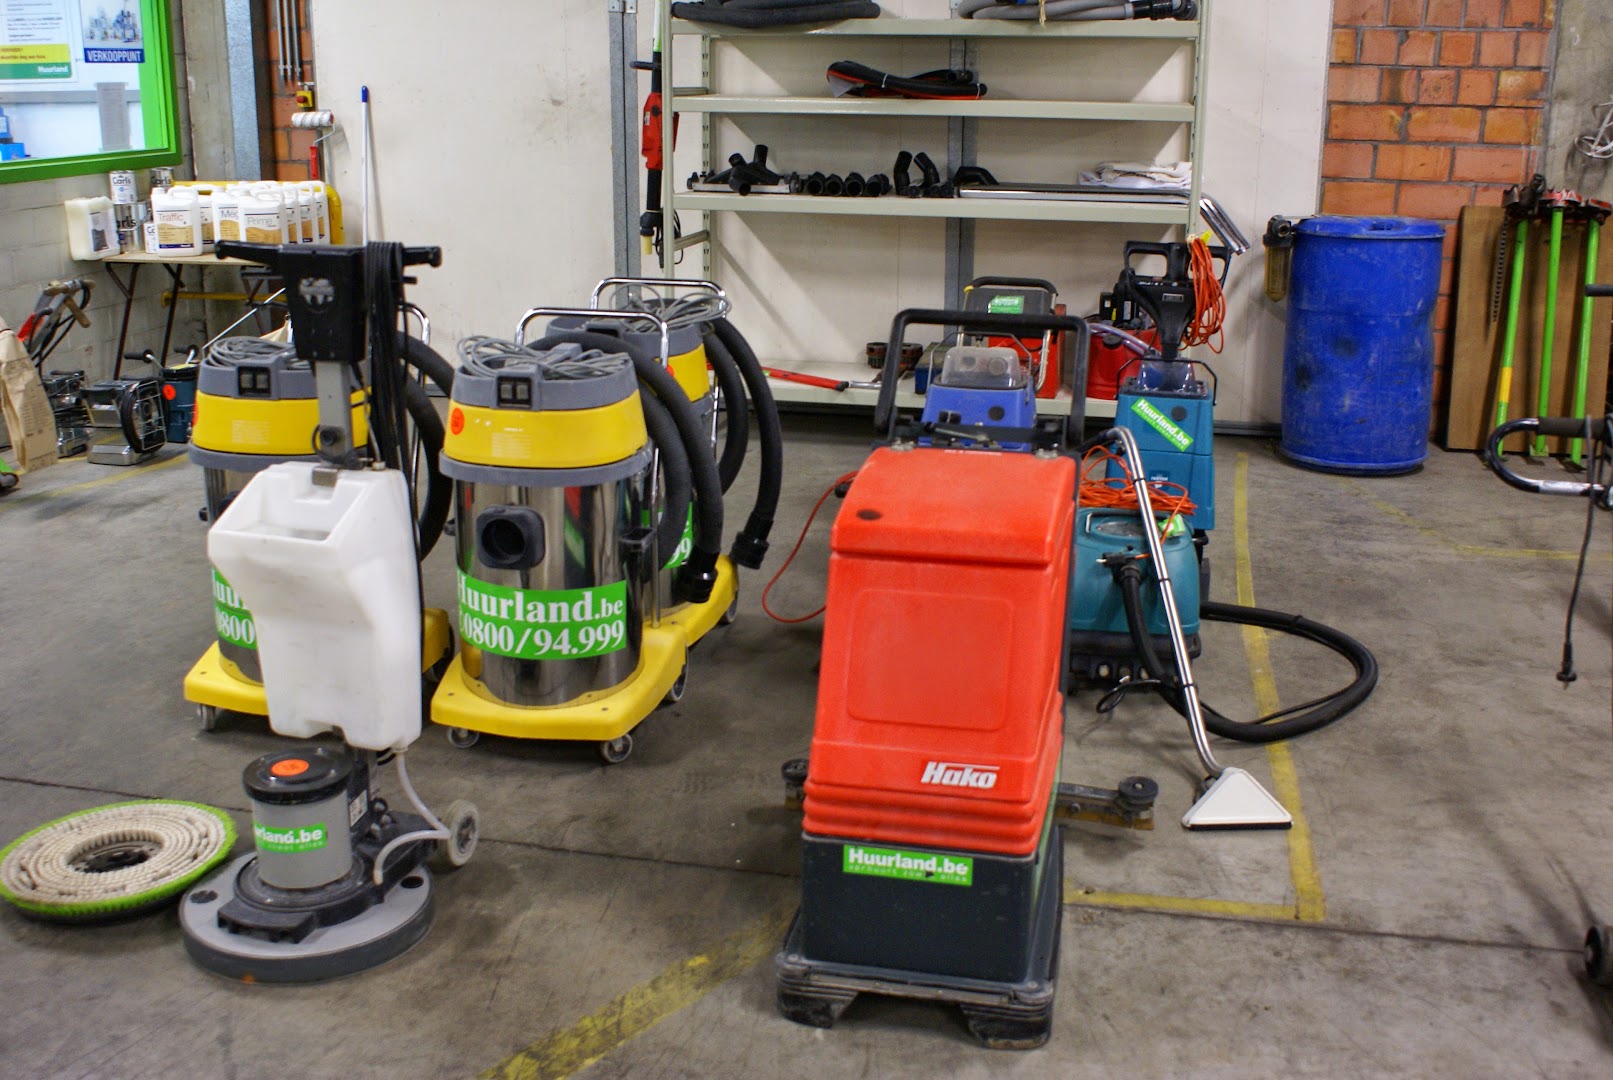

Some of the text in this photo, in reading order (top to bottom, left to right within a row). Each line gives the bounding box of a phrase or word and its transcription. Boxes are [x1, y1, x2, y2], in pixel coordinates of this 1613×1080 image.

[87, 50, 141, 62] VERKOOPPUNT
[159, 213, 185, 222] Traffic
[247, 217, 273, 226] Prime
[921, 761, 1000, 789] Hako
[848, 847, 969, 875] Huurland.be
